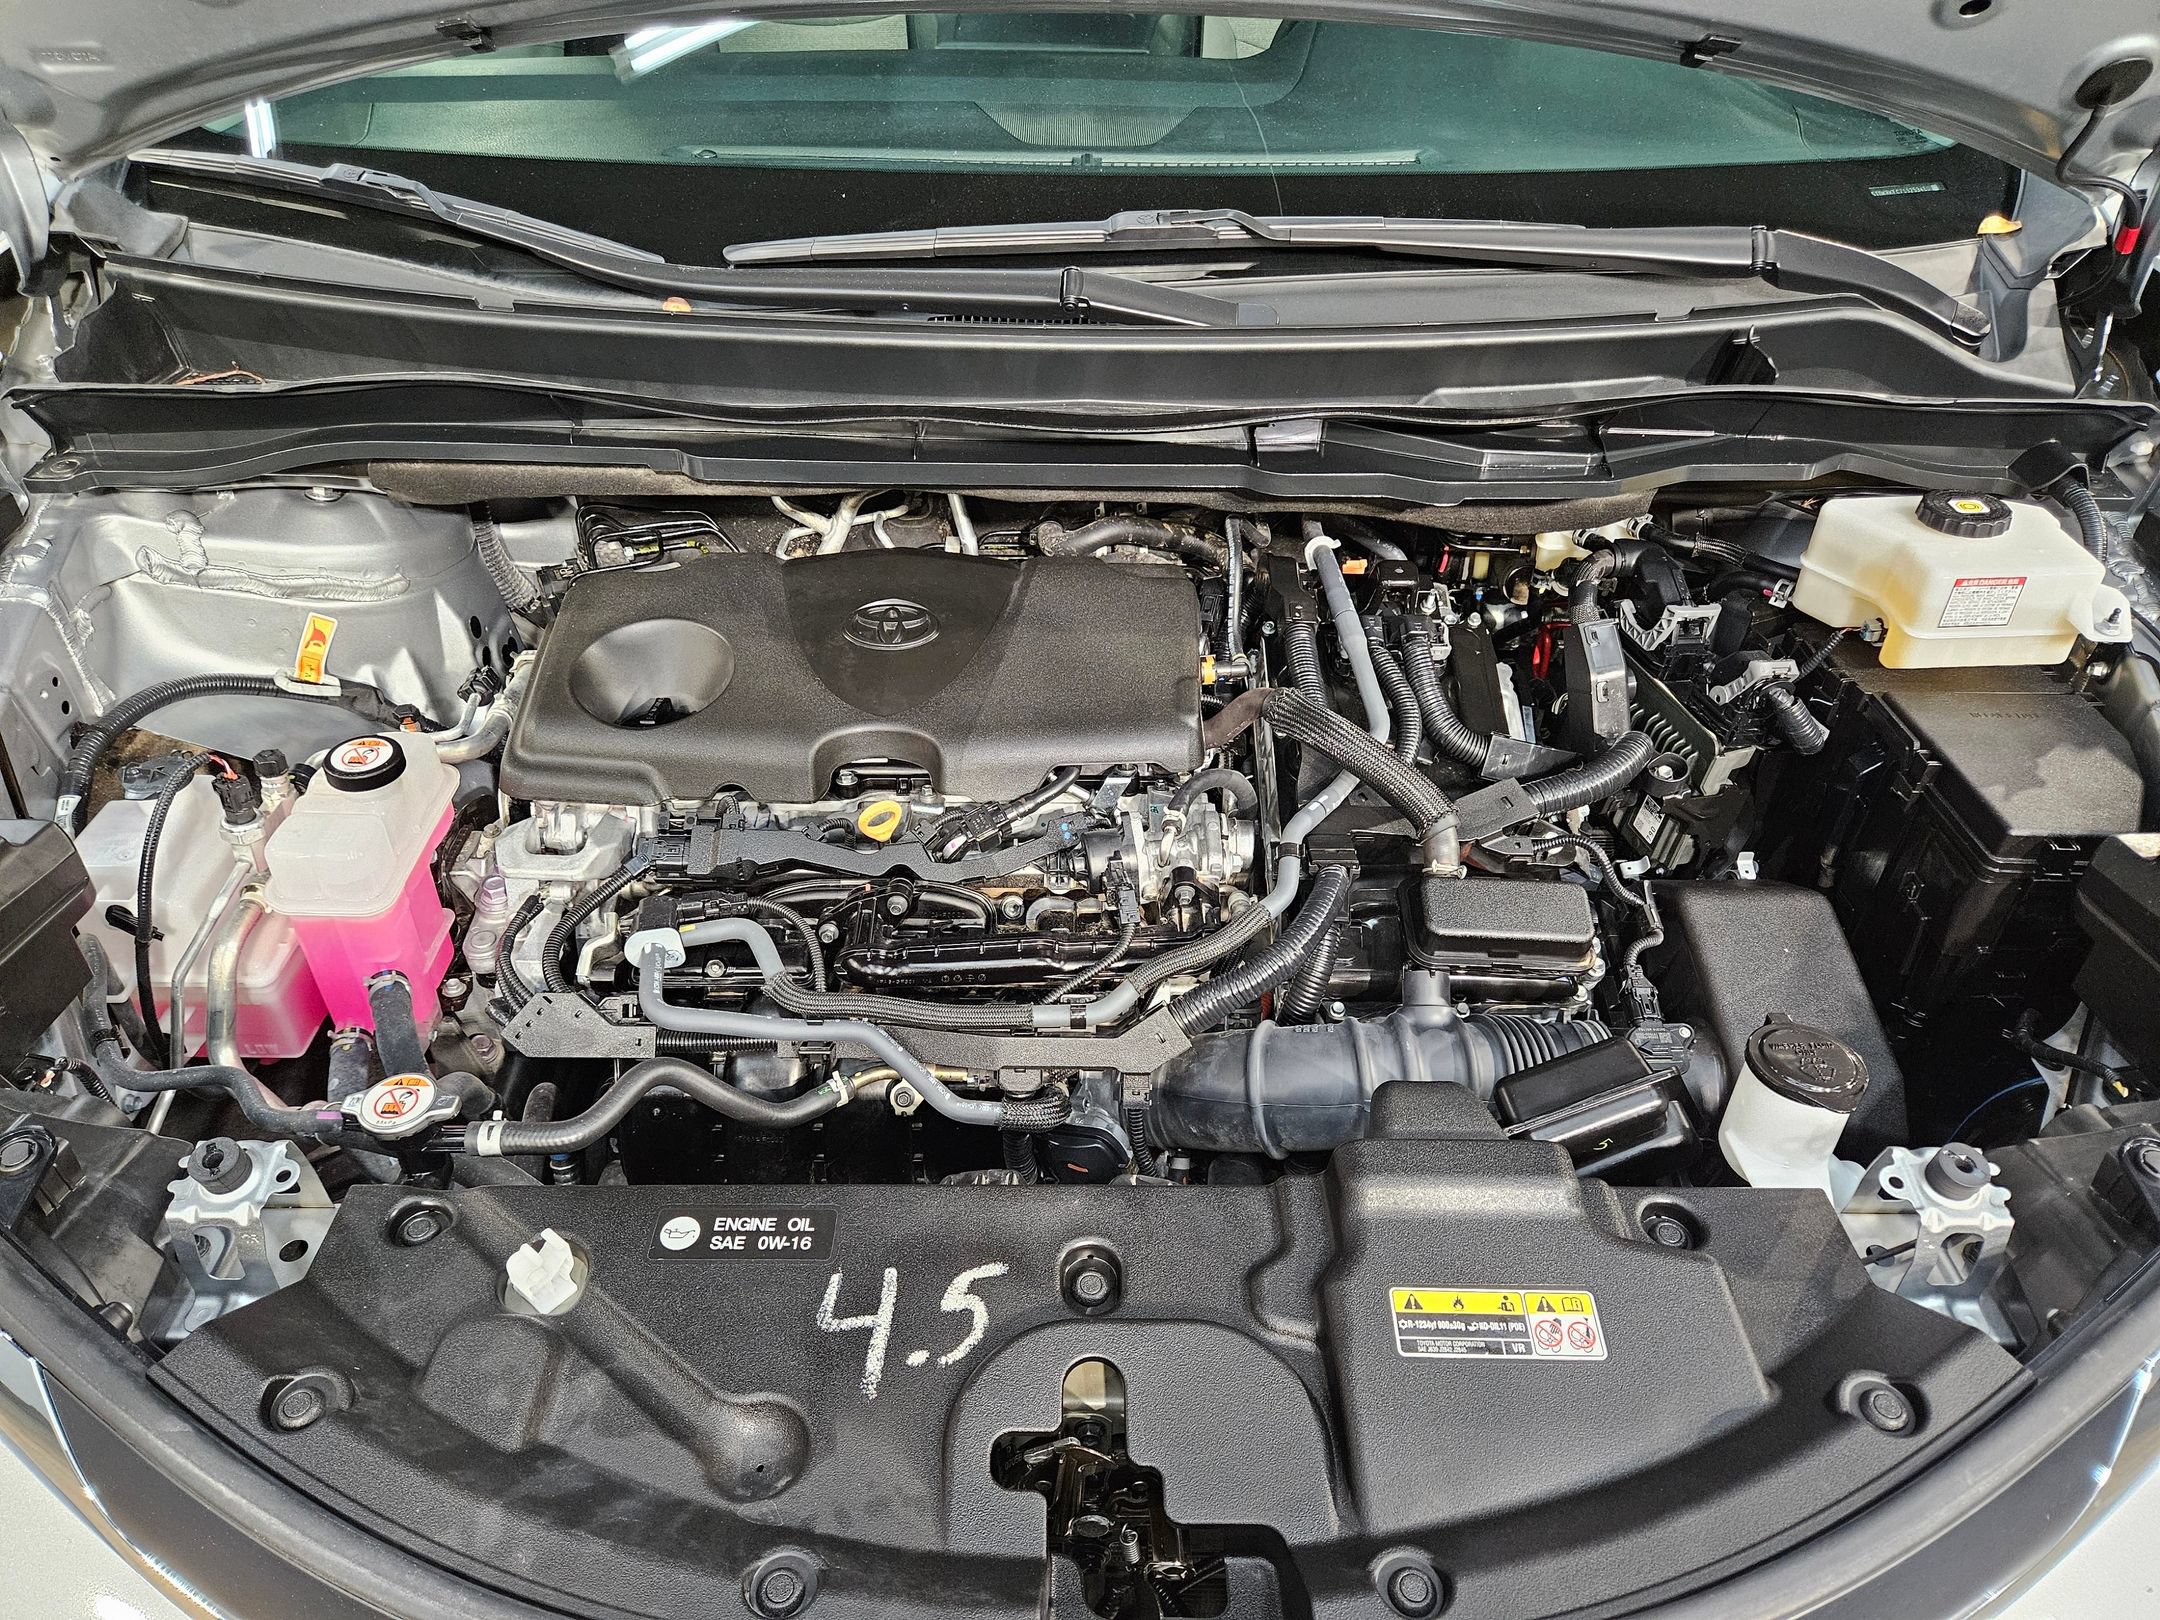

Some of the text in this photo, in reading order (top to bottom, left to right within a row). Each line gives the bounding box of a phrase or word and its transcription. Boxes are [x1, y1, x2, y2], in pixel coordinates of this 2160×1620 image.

[713, 1217, 815, 1231] ENGINE OIL
[709, 1235, 812, 1250] SAE 0W-16
[815, 1261, 1010, 1400] 4.5
[1416, 1339, 1435, 1347] TOYOTA
[1511, 1342, 1527, 1354] VR
